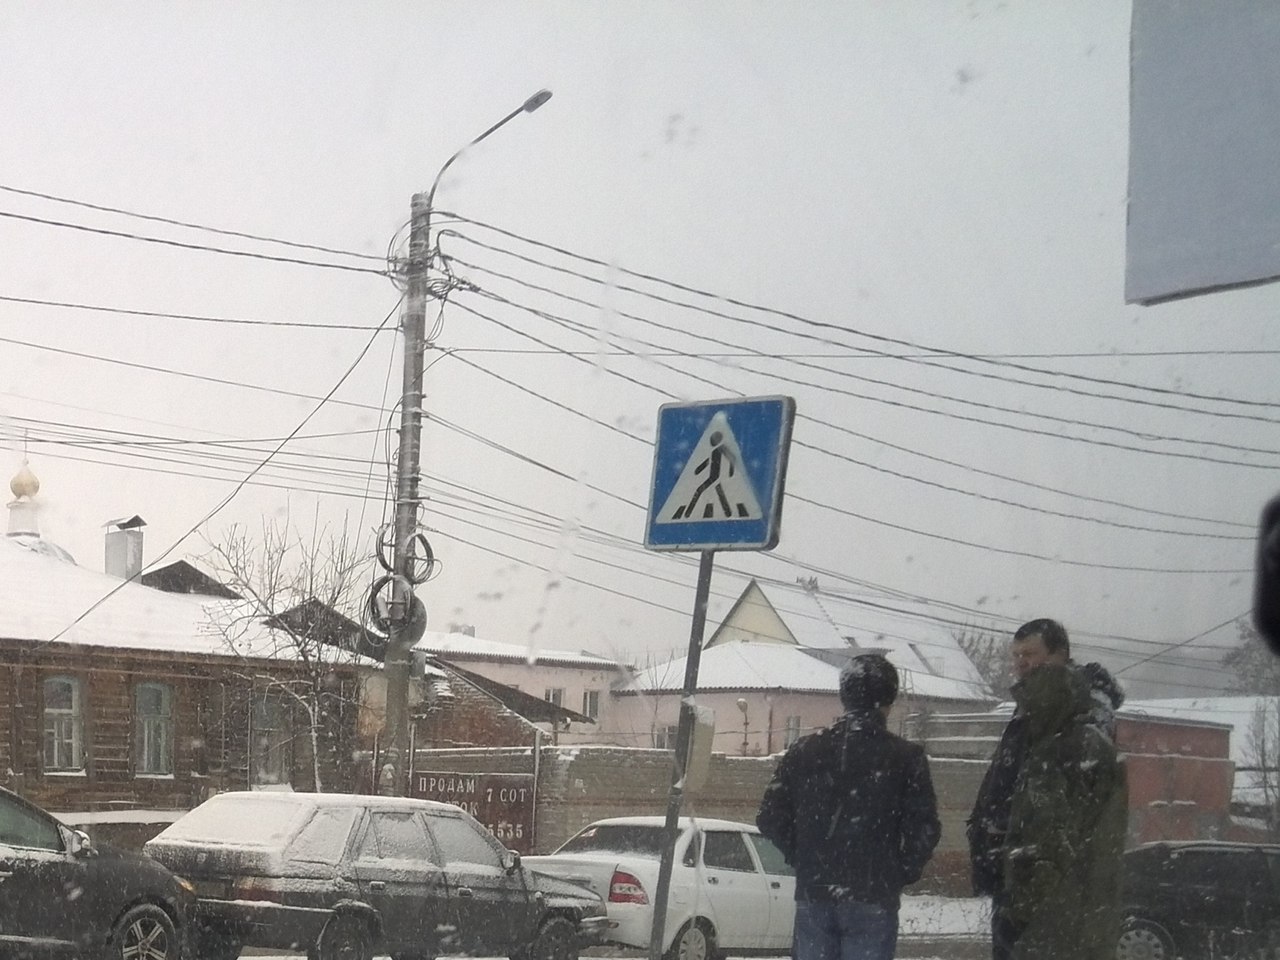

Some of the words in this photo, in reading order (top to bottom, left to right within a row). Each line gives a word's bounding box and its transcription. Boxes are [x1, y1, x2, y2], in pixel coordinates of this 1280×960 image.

[419, 777, 475, 793] ПРОДАМ
[486, 788, 493, 802] 7
[500, 788, 527, 803] СОТ
